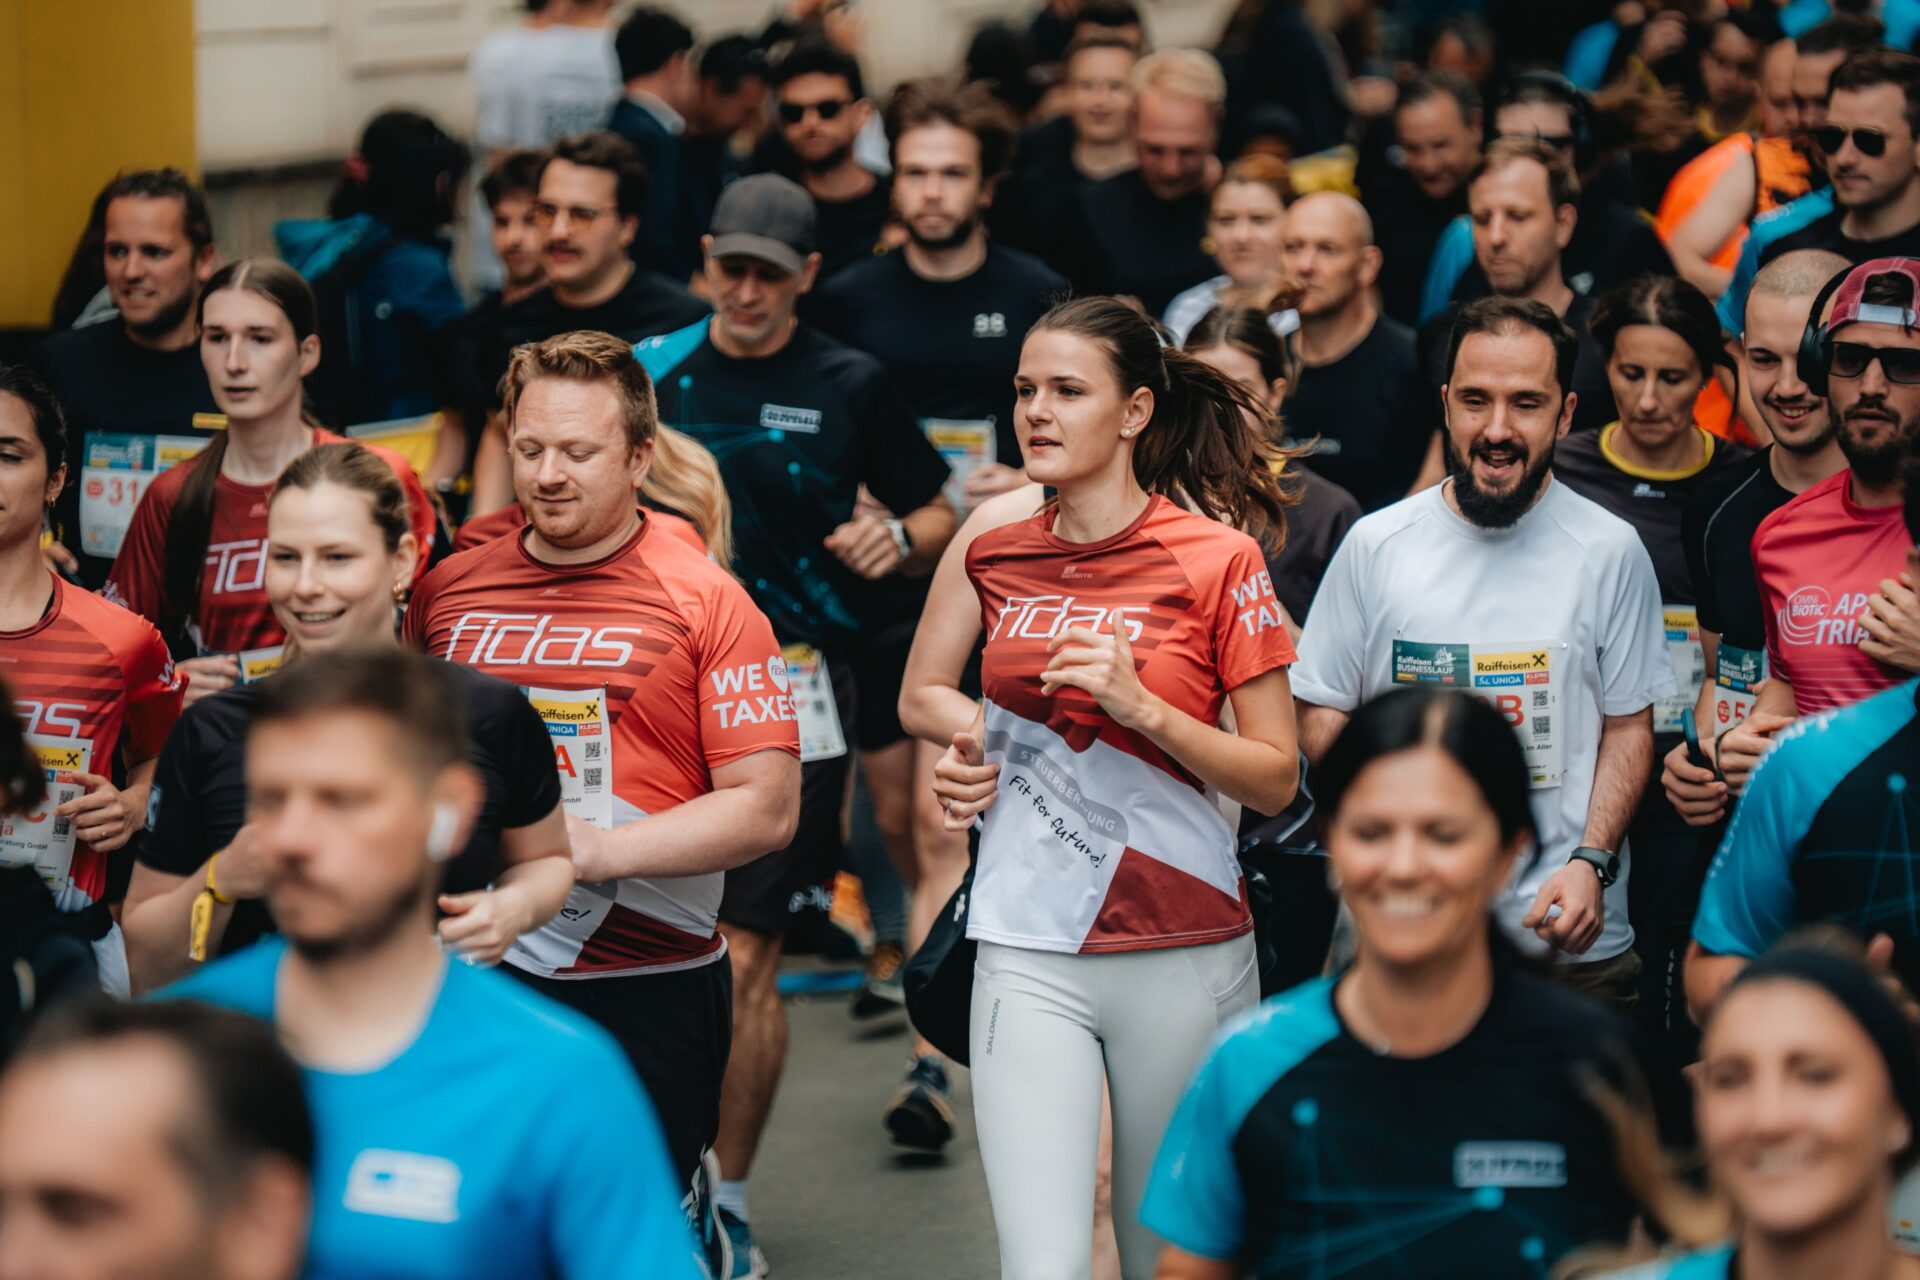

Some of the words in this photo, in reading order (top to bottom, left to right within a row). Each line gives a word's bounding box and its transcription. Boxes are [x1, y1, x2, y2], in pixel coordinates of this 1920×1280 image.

[1230, 570, 1273, 608] WE
[1832, 592, 1871, 616] AP
[990, 595, 1150, 642] fidas
[444, 612, 642, 668] fidas
[711, 663, 765, 697] WE
[1477, 661, 1531, 672] Raiffeisen
[1492, 676, 1521, 685] UNIQA
[712, 694, 799, 729] TAXES
[1008, 775, 1032, 796] Fit
[1032, 795, 1051, 818] for
[1050, 817, 1107, 868] future!
[986, 998, 1001, 1056] SALOMON
